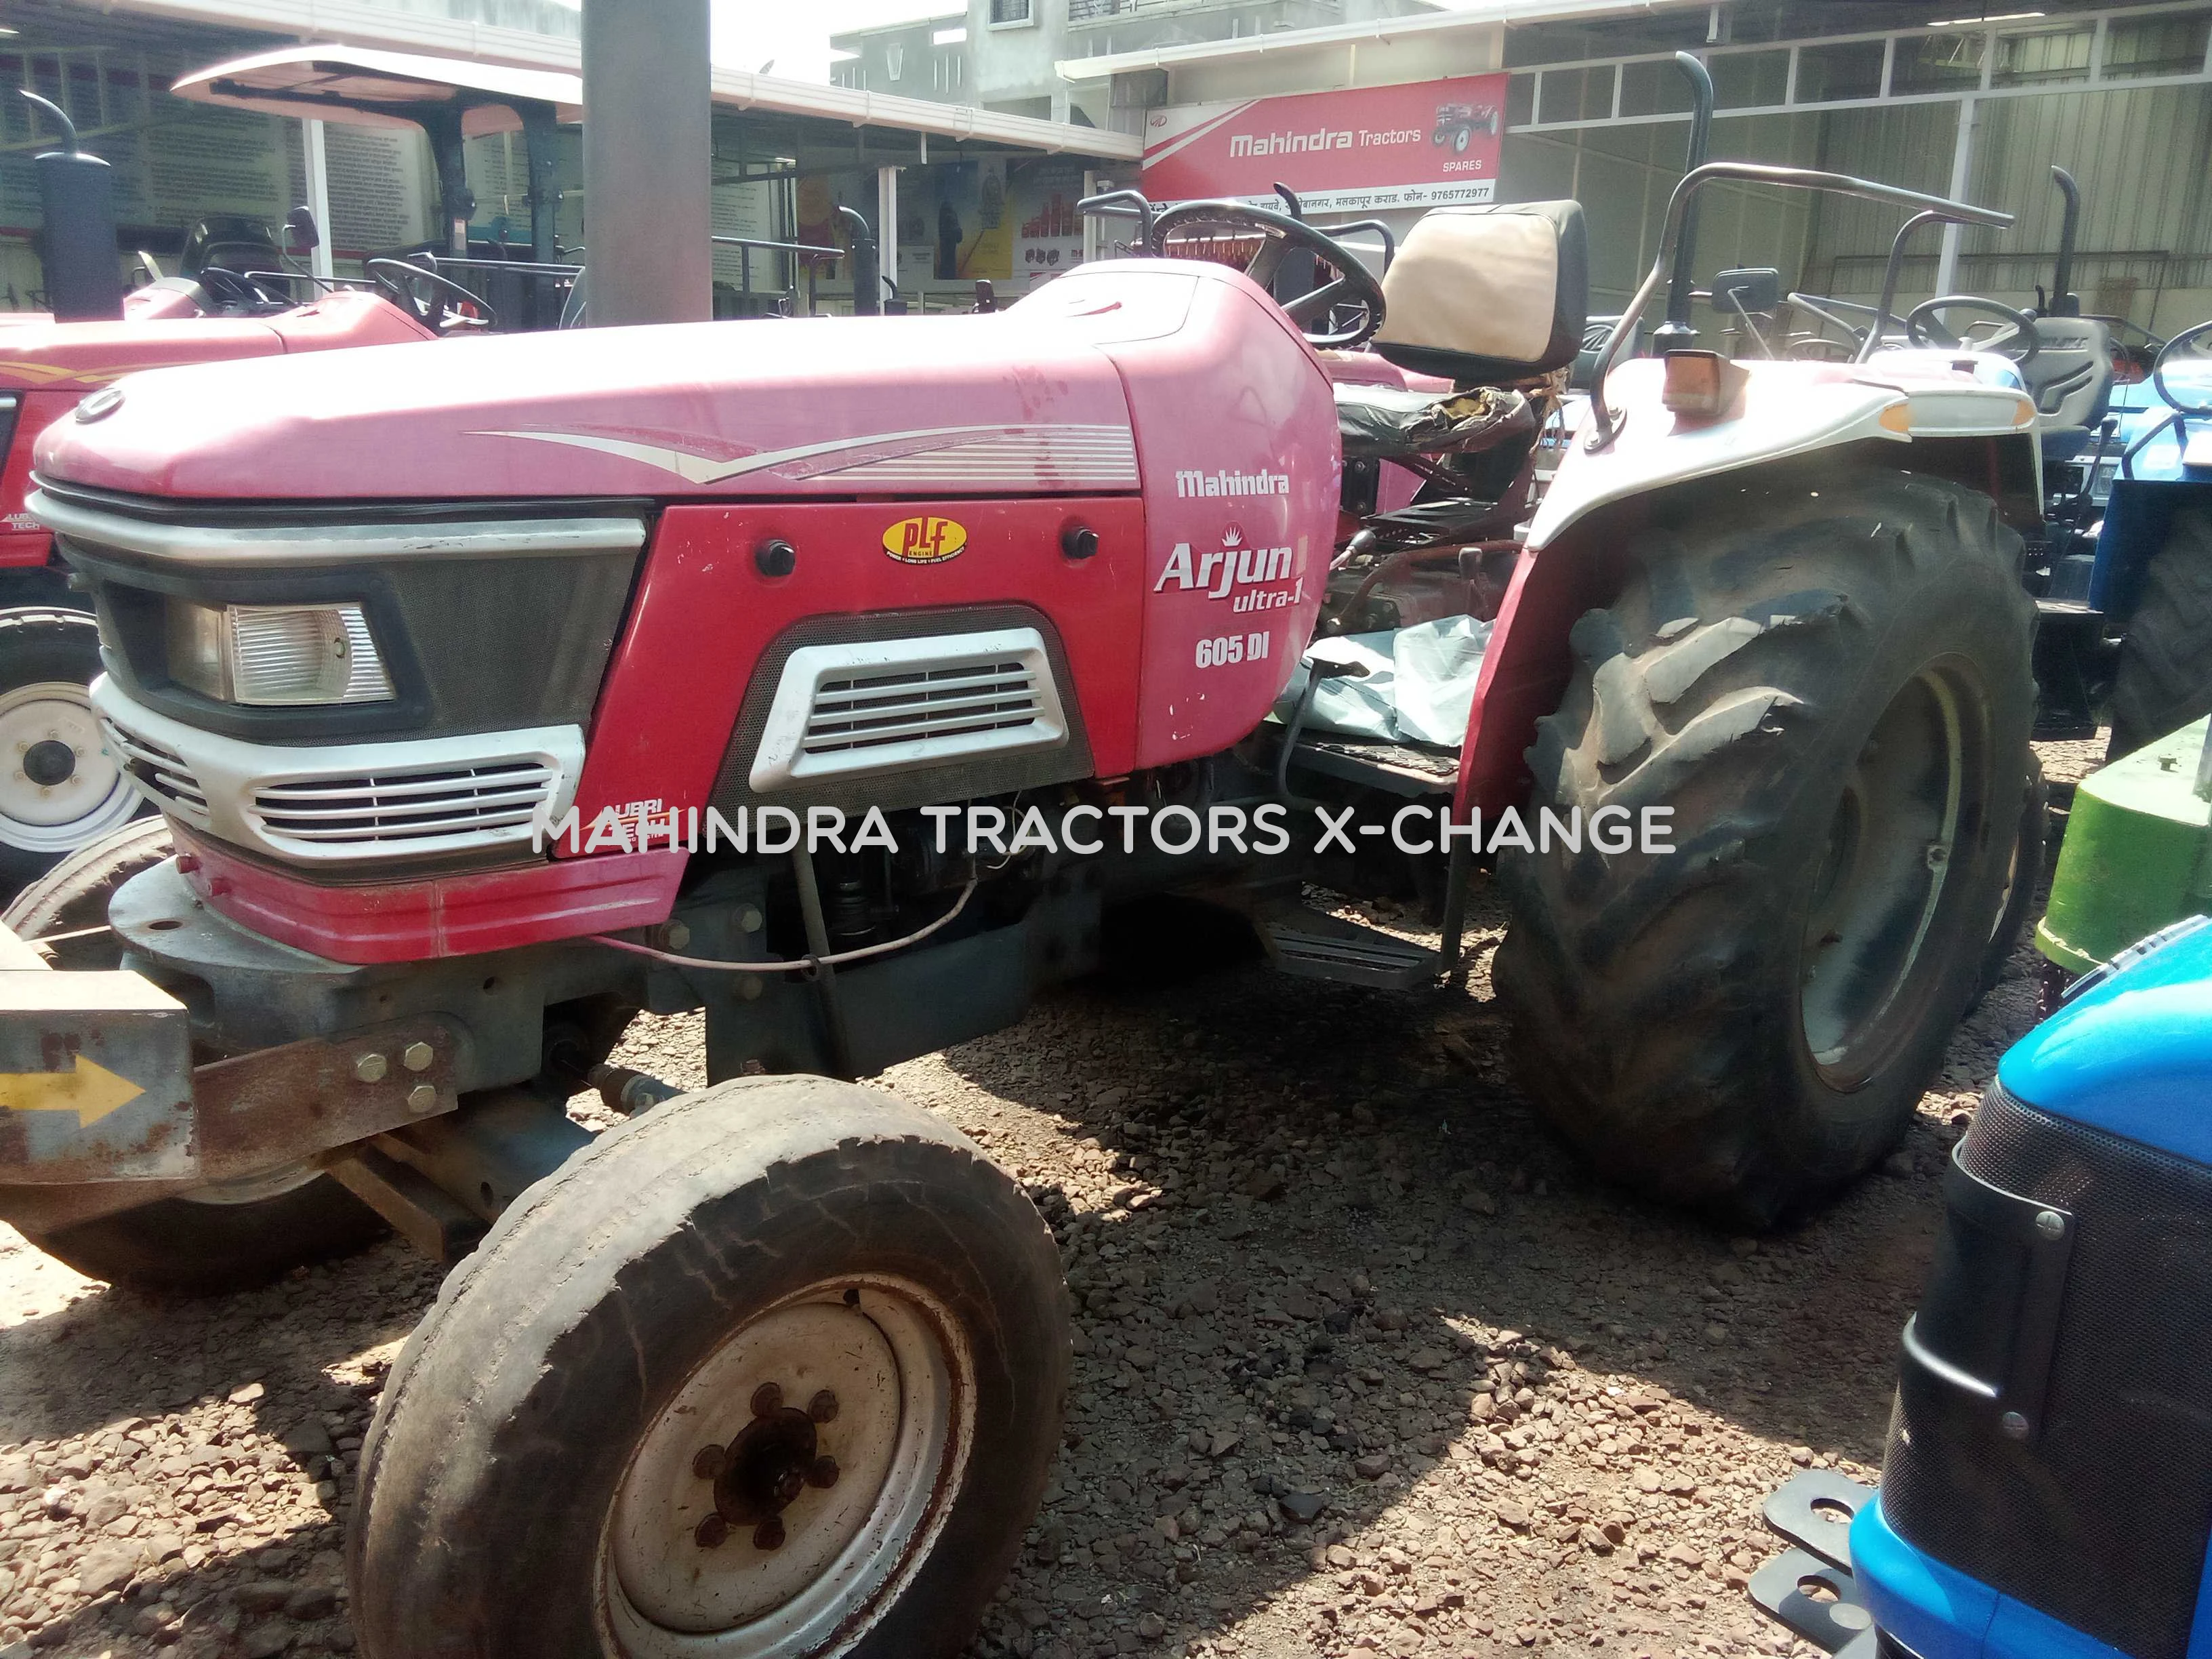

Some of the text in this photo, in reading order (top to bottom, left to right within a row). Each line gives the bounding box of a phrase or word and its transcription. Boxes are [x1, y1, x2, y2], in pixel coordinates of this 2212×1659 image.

[1229, 127, 1422, 158] Mahindra Tractors
[1442, 159, 1483, 173] SPARES
[1431, 187, 1490, 201] 9765772977
[1175, 468, 1290, 498] Mahindra
[1153, 541, 1294, 600] Arjun
[1195, 630, 1271, 669] 605 DI
[614, 798, 663, 819] UBRI
